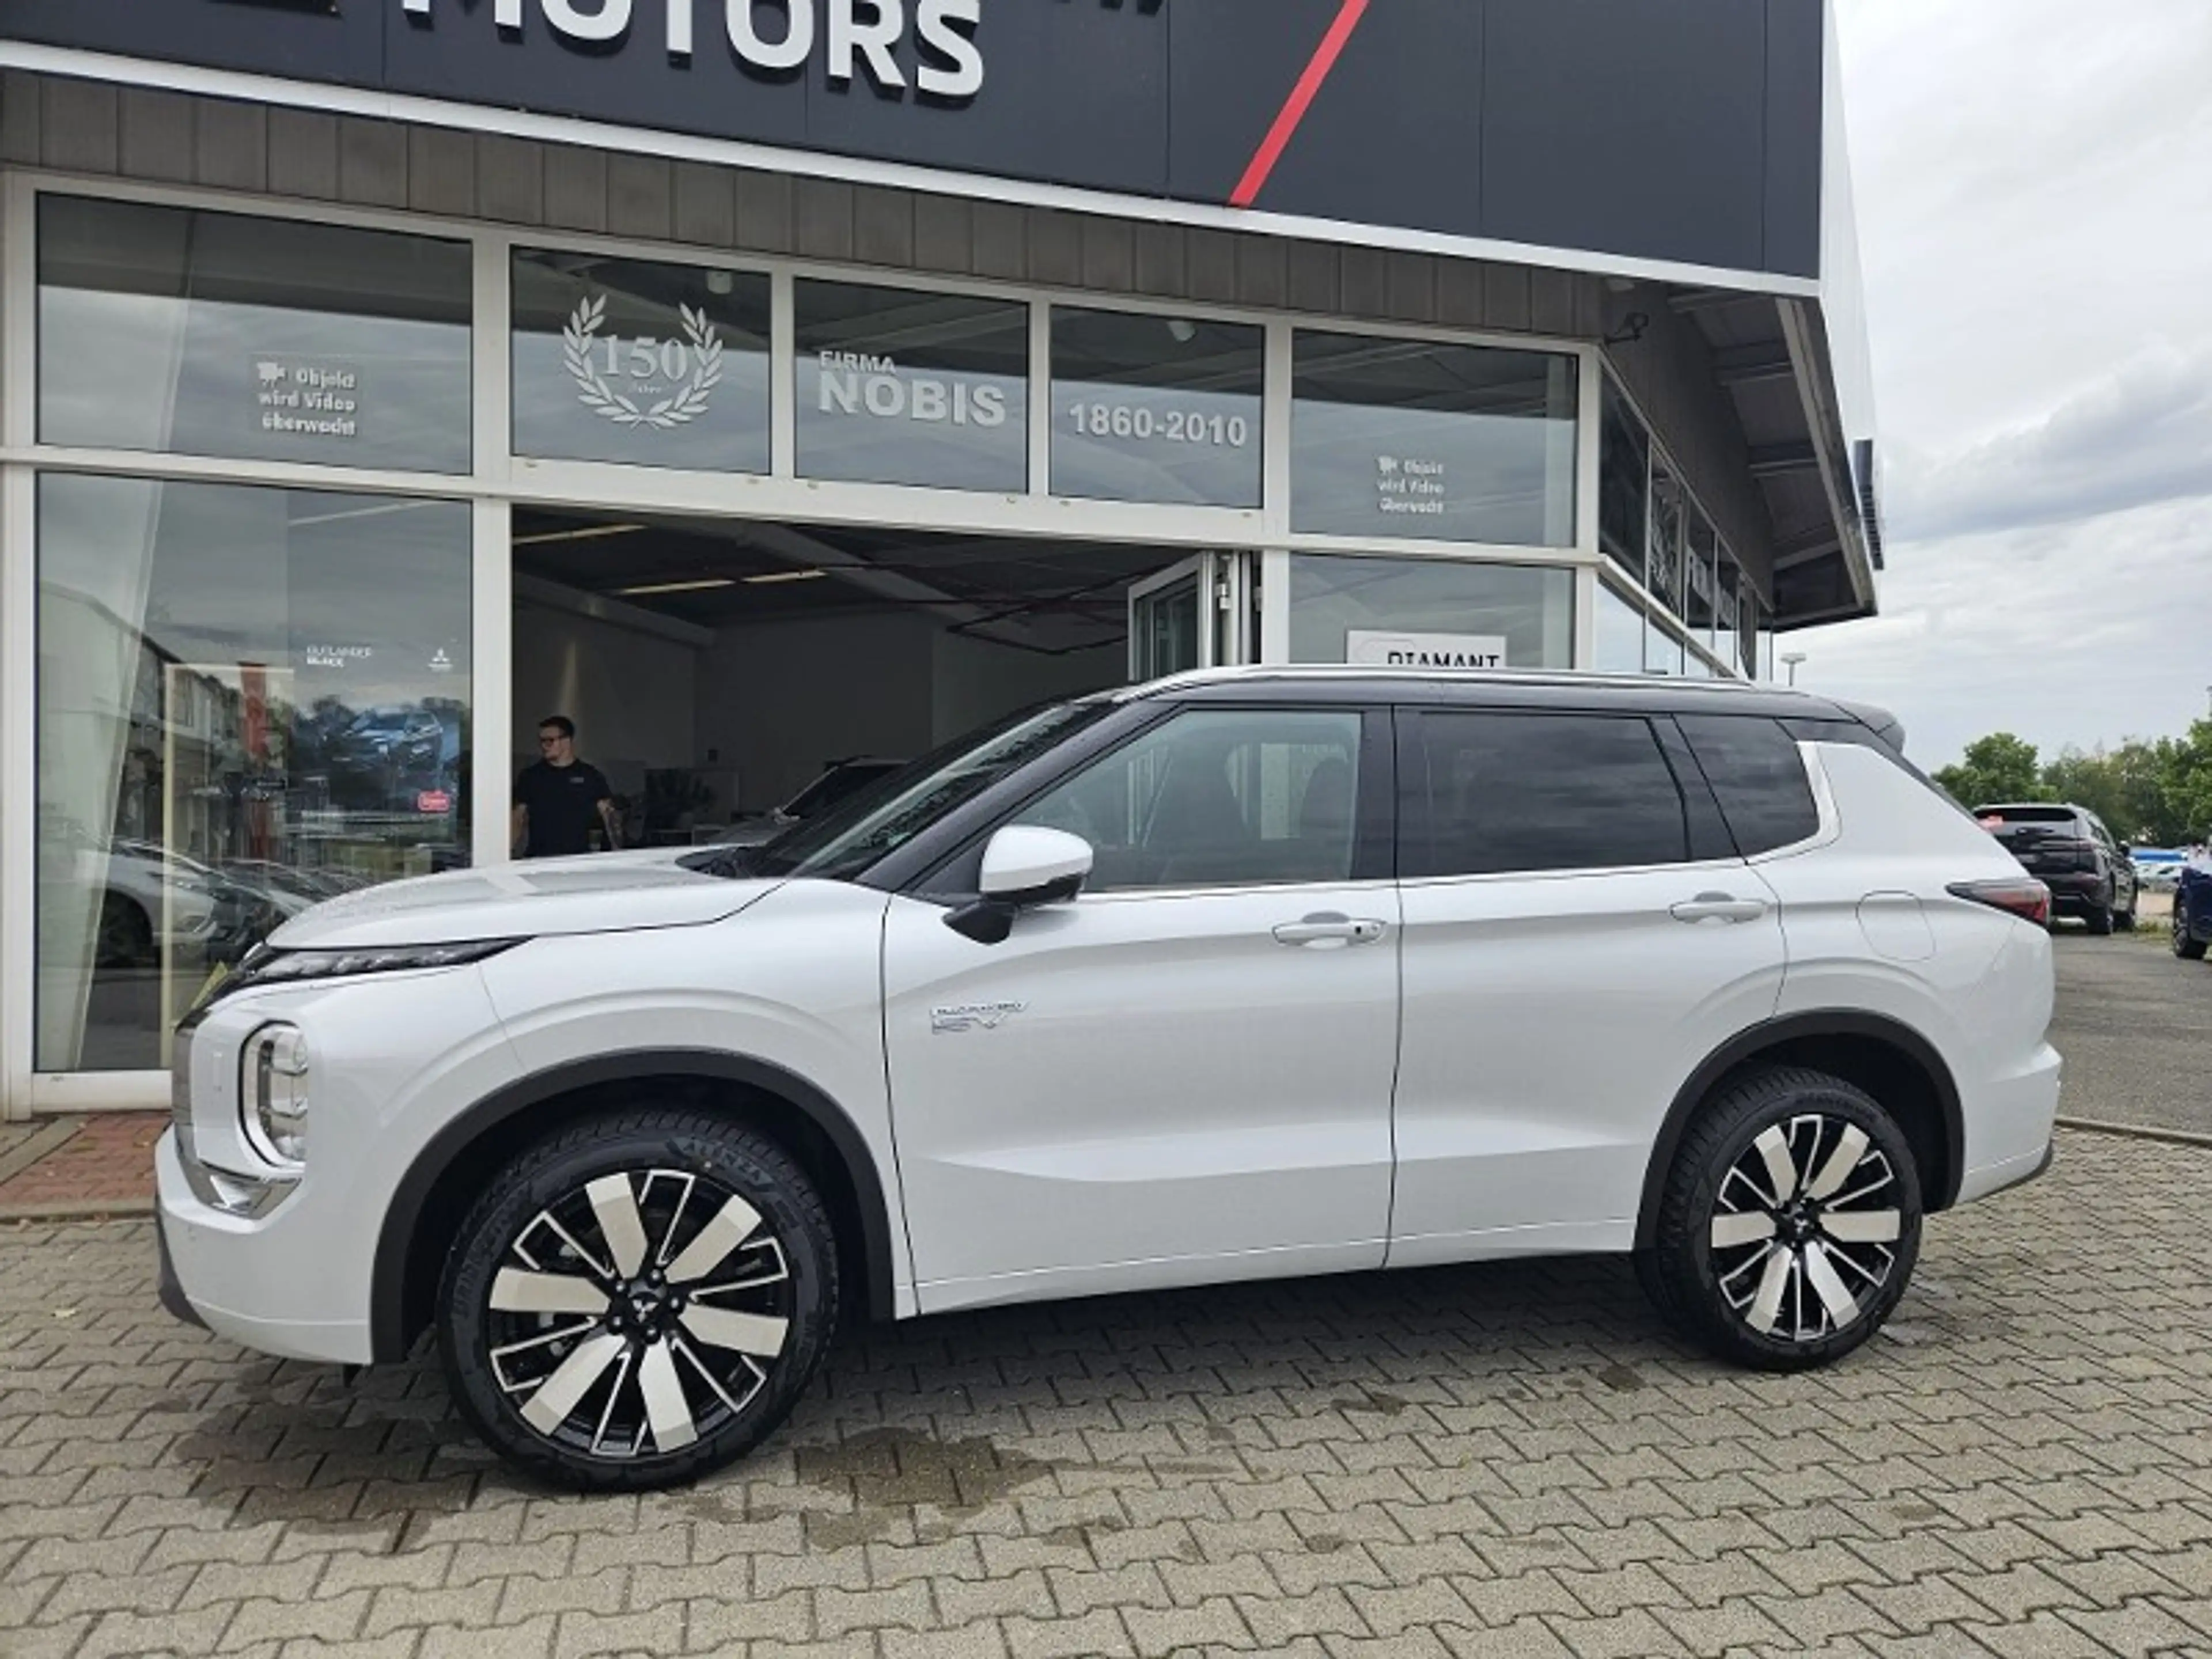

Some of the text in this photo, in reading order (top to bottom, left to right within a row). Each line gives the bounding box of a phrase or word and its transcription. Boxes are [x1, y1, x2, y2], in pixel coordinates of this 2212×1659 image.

[403, 0, 984, 96] ORS
[603, 335, 687, 381] 150
[820, 350, 897, 374] FIRMA
[819, 372, 1006, 427] NOBIS
[1070, 404, 1246, 446] 1860-2010
